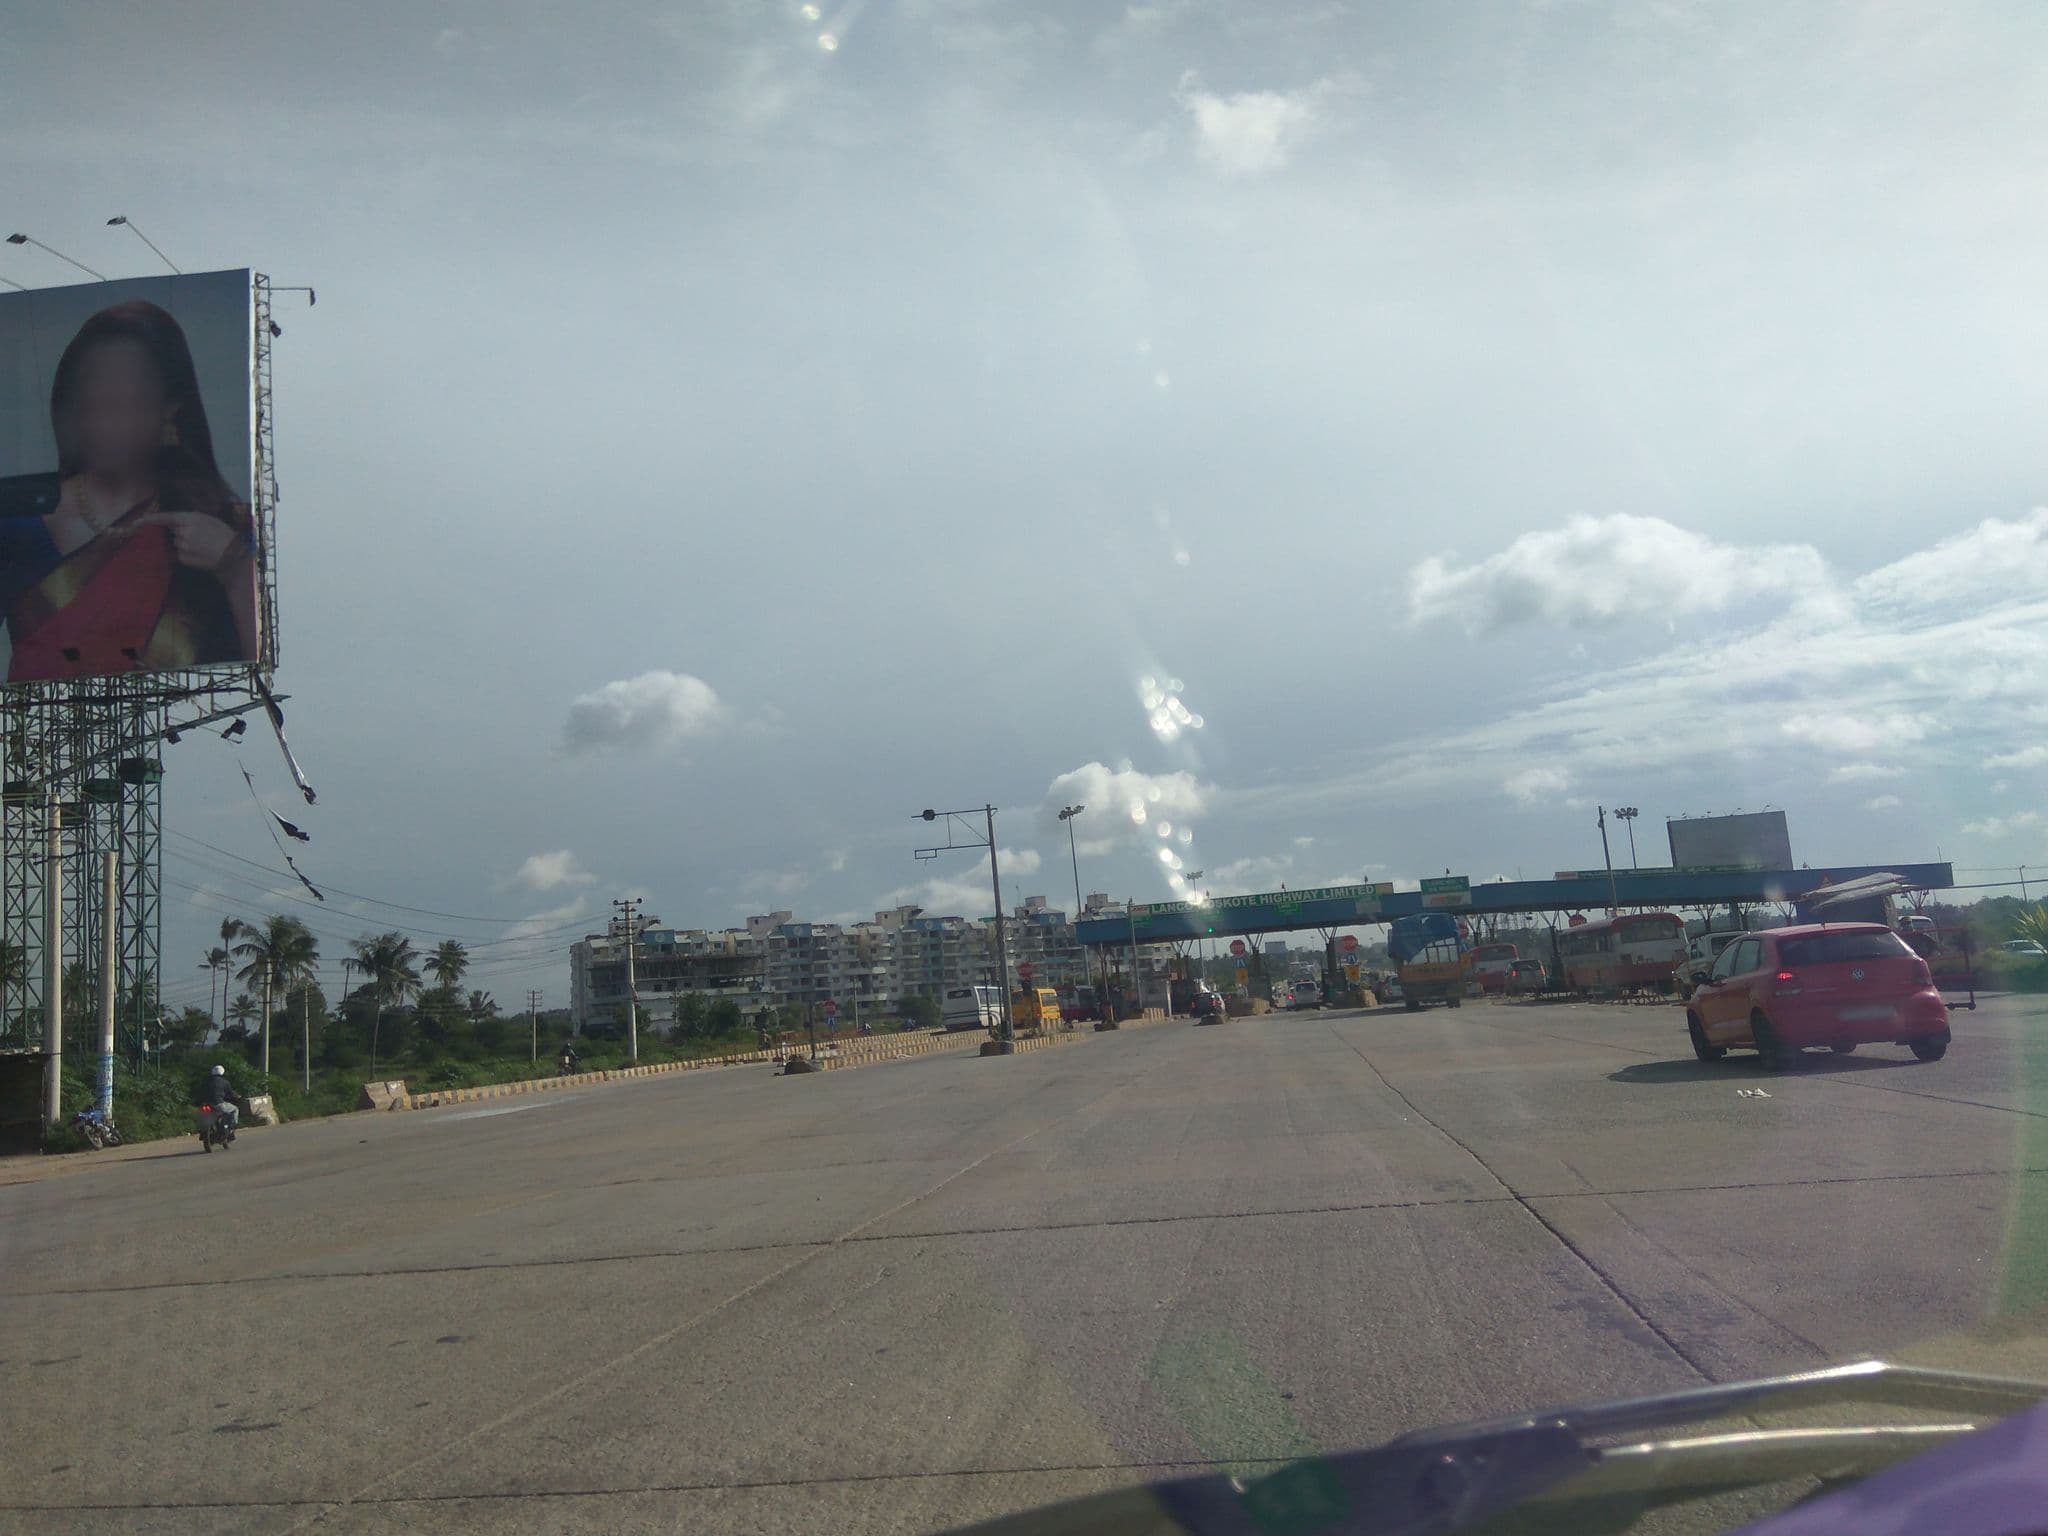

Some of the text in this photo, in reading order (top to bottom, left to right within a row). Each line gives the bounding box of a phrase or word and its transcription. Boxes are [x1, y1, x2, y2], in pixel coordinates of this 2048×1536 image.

[1151, 902, 1192, 913] LANCO
[1198, 895, 1257, 910] OSKOTE
[1260, 889, 1320, 904] HIGHWAY
[1322, 885, 1375, 898] LIMITED
